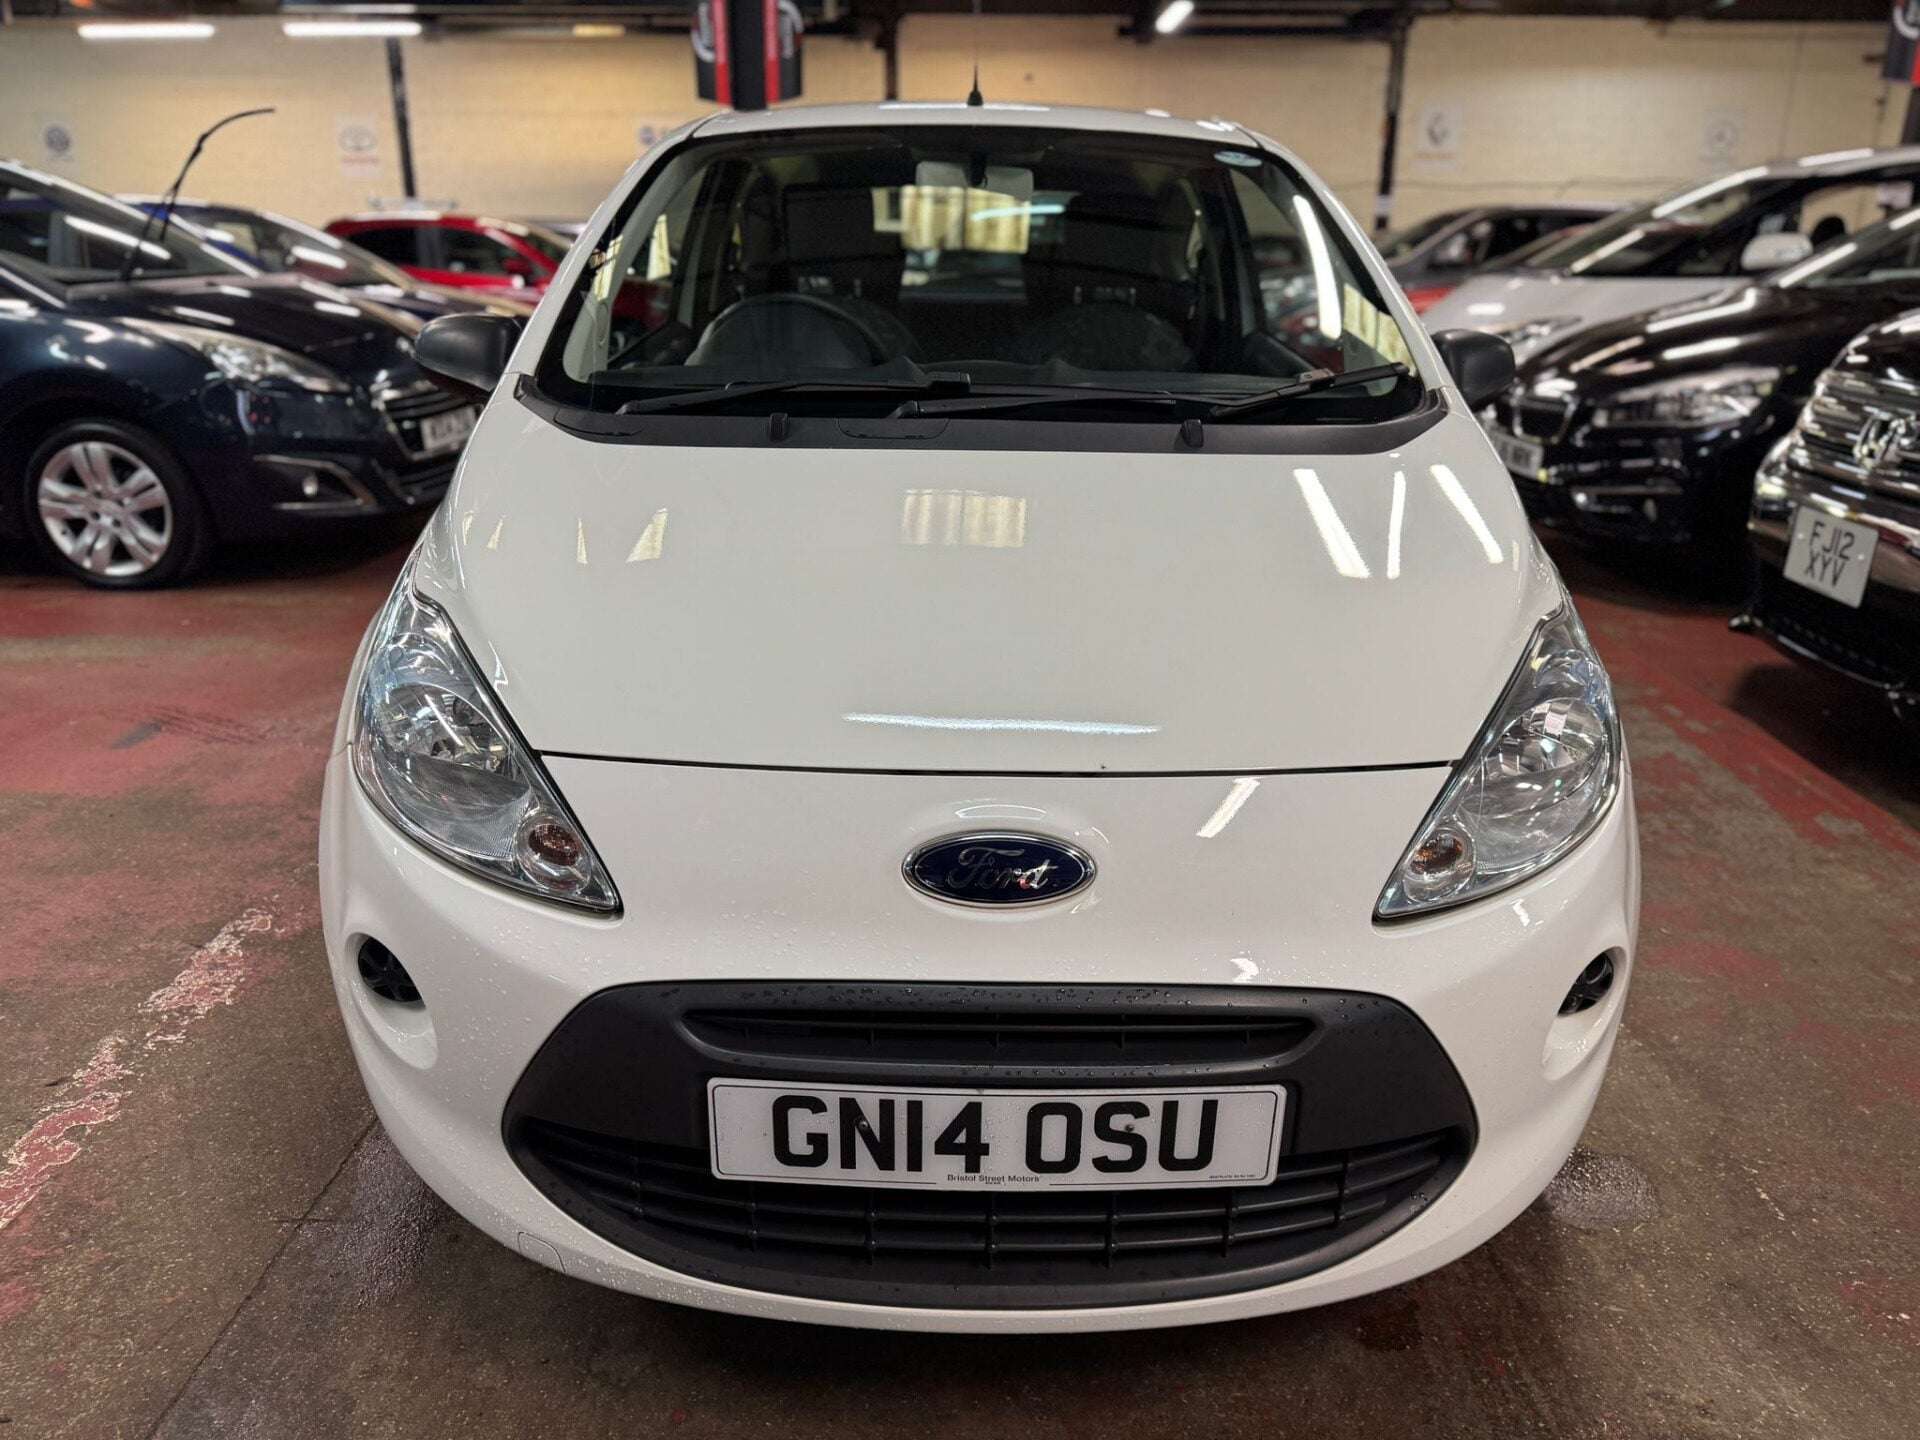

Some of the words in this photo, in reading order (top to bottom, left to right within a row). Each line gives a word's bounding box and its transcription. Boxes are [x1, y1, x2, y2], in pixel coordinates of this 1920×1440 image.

[1809, 520, 1855, 561] FJ12
[1804, 551, 1847, 587] XYV
[946, 846, 1059, 890] Ford
[772, 1093, 989, 1174] GN14
[1025, 1099, 1219, 1174] OSU
[947, 1174, 976, 1182] Bristol
[979, 1174, 1005, 1183] Street
[1008, 1175, 1040, 1183] Motors
